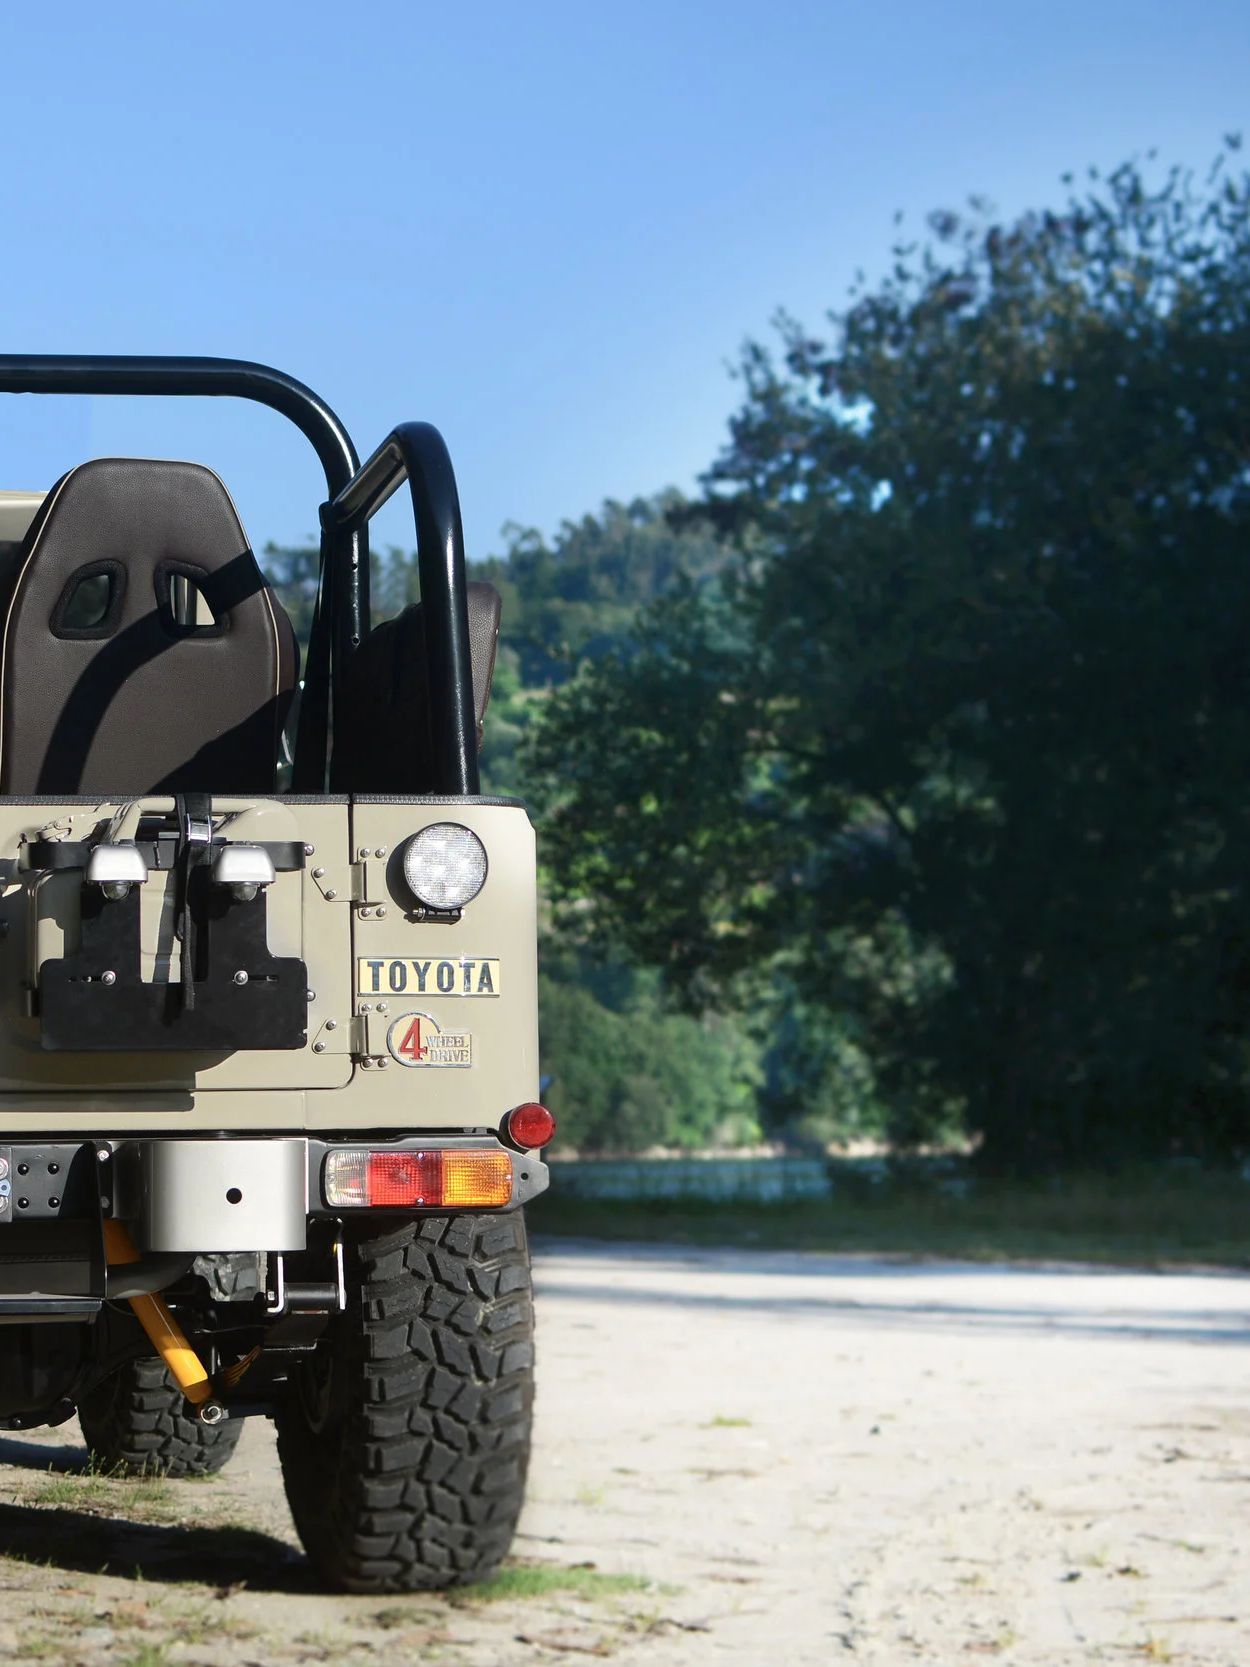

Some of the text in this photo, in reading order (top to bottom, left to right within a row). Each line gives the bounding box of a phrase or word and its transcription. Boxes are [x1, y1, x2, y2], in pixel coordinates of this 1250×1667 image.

[366, 960, 494, 993] TOYOTA
[398, 1017, 469, 1061] 4 WHEEL
[429, 1049, 469, 1062] DRIVE
